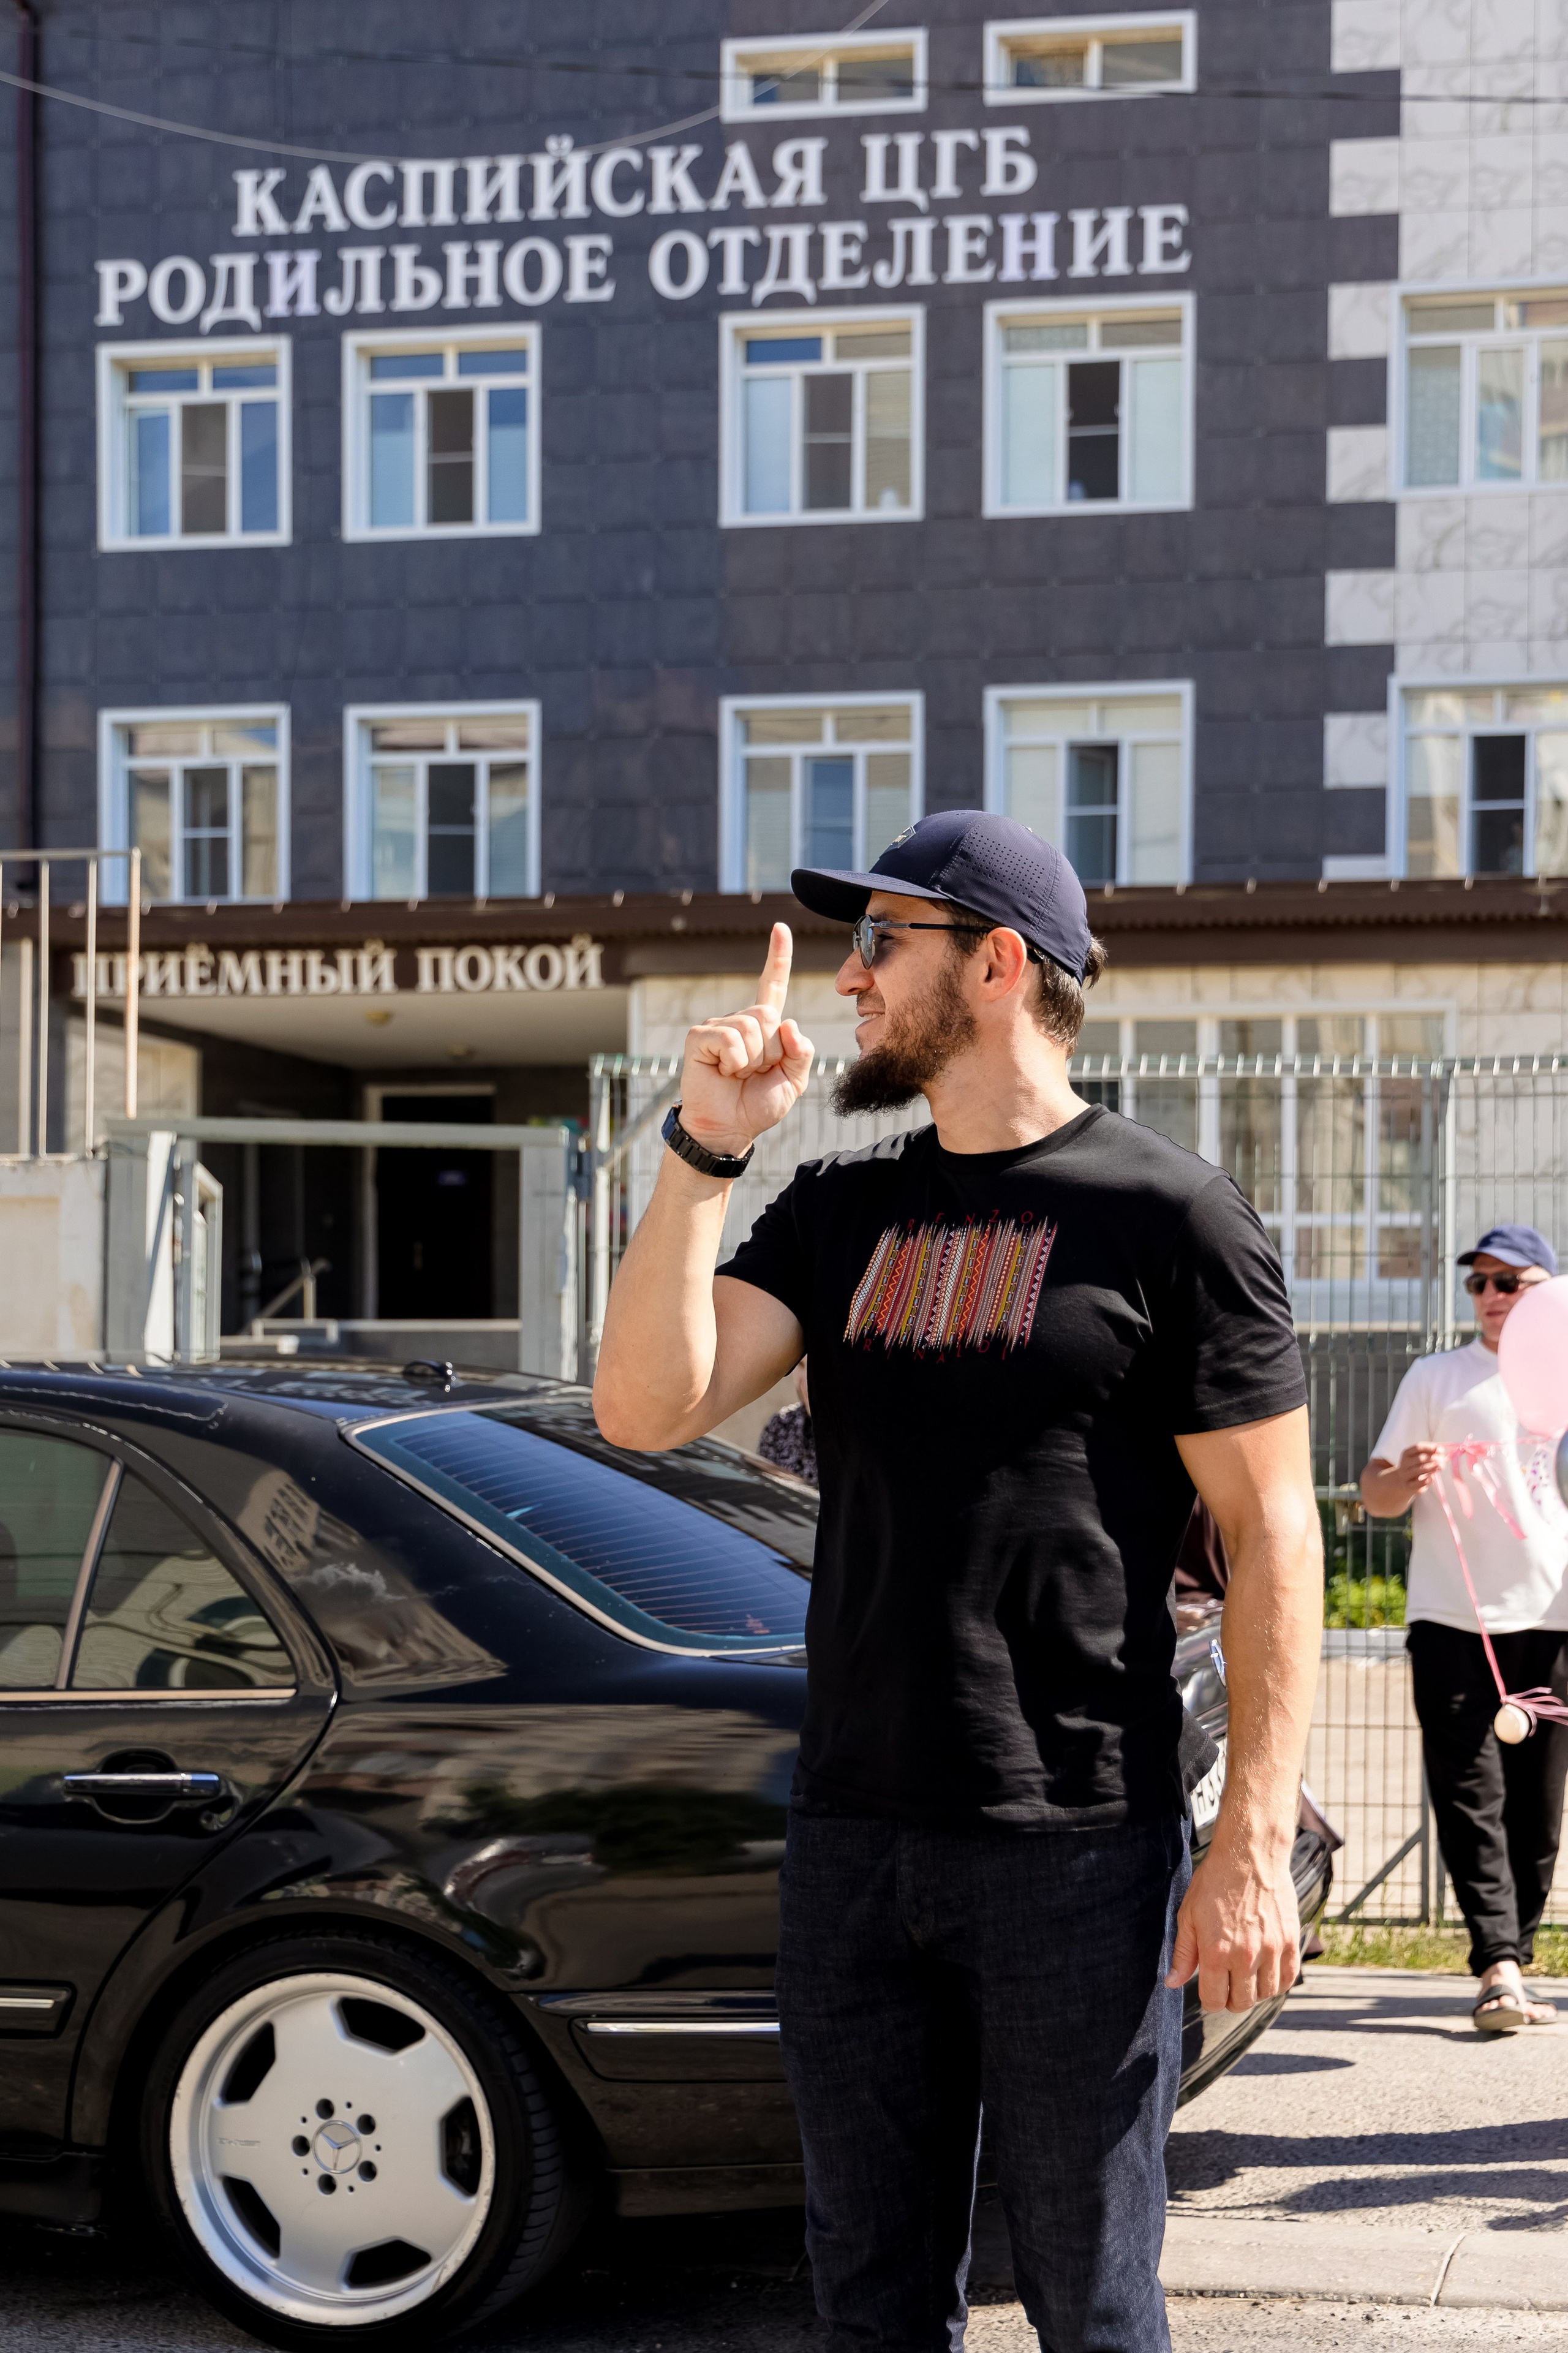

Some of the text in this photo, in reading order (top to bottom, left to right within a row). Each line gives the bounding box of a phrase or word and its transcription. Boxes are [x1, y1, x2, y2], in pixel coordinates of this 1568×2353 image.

[232, 126, 1038, 237] КАСПИЙСКАЯ ЦГБ
[94, 204, 1192, 335] РОДИЛЬНОЕ ОТДЕЛЕНИЕ
[416, 933, 605, 991] ПОКОЙ
[907, 1209, 1033, 1231] RENZO
